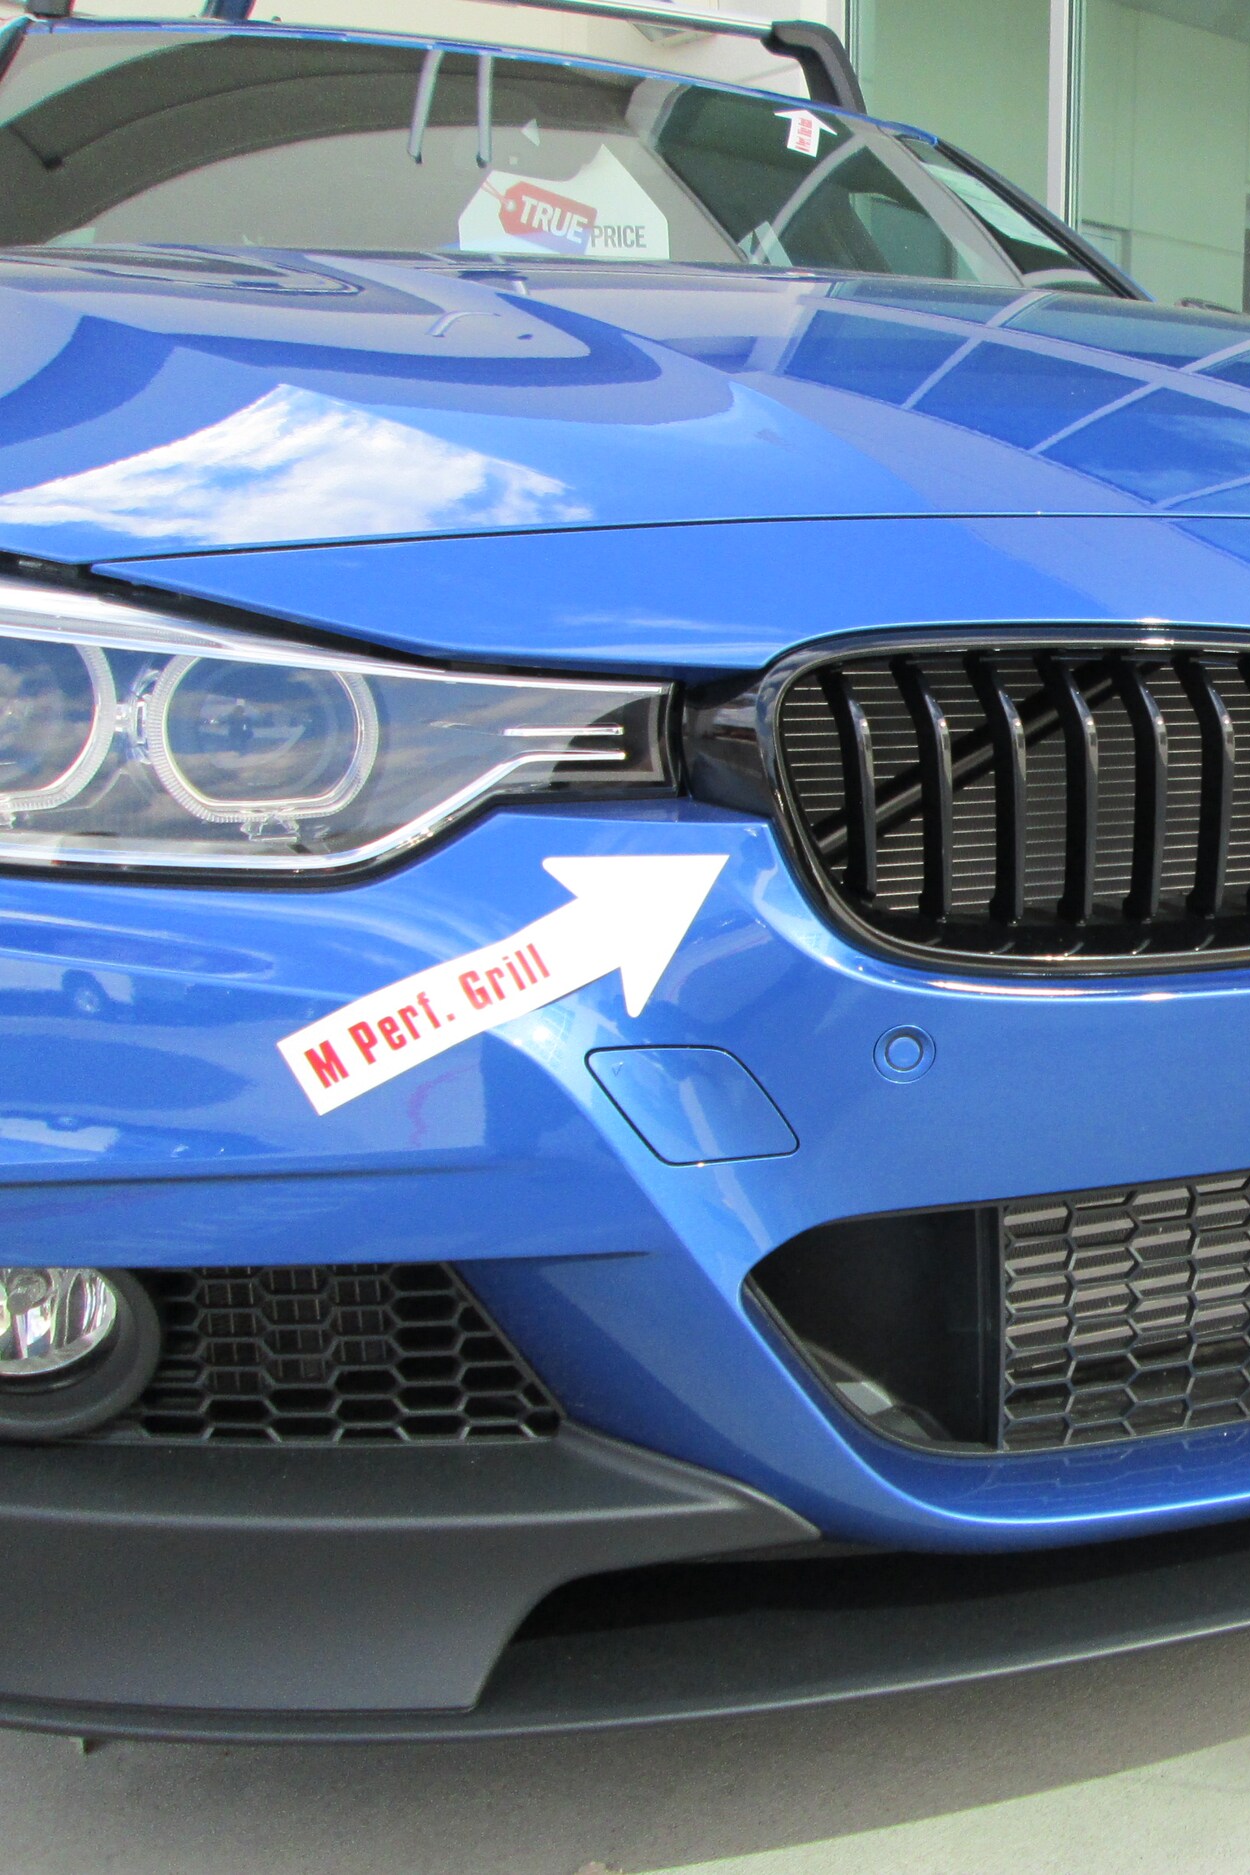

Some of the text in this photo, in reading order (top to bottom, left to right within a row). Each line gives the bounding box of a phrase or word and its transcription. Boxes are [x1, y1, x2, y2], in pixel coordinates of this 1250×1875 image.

[518, 194, 647, 249] TRUE PRICE
[304, 943, 550, 1089] M Perf. Grill
